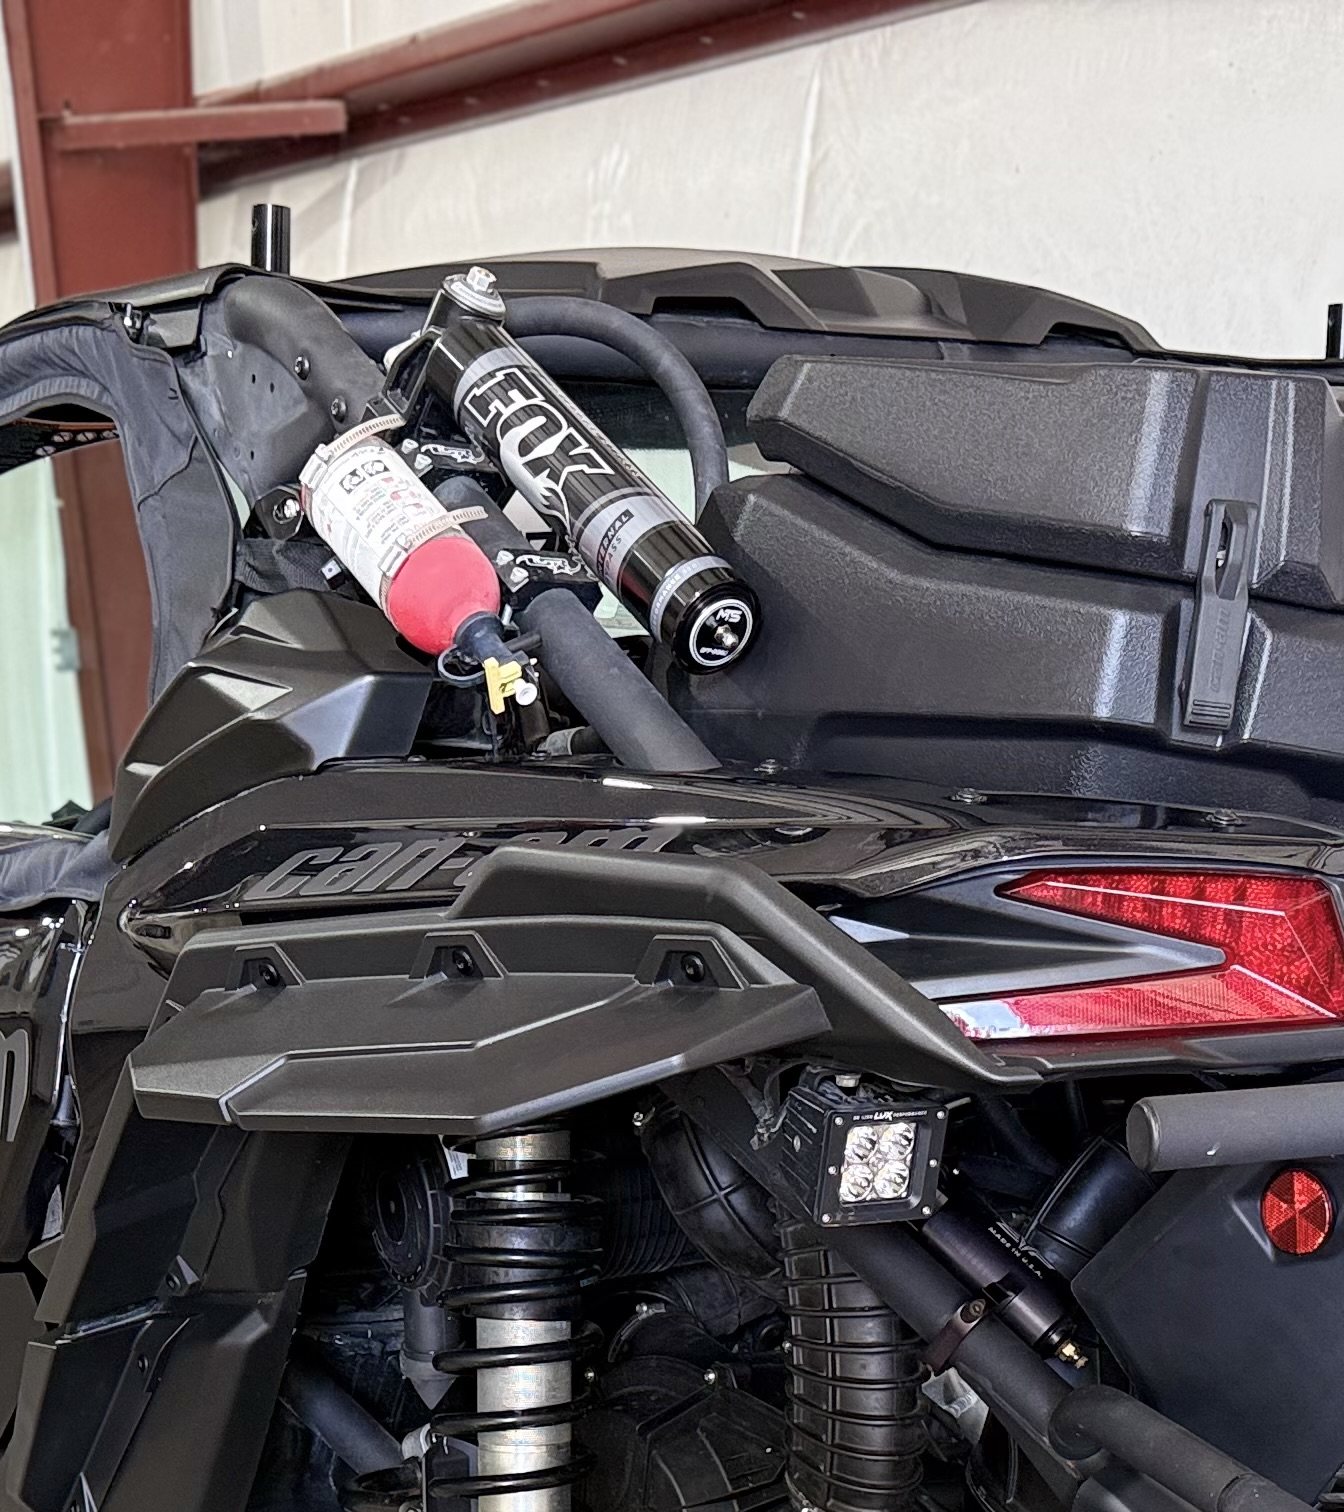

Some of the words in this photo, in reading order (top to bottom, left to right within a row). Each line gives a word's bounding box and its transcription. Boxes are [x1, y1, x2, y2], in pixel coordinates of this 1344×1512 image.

[463, 366, 617, 510] FOX
[597, 512, 630, 575] NTERNAL
[873, 1110, 894, 1121] LUX
[988, 1226, 1012, 1248] MADE
[1011, 1247, 1022, 1258] IN
